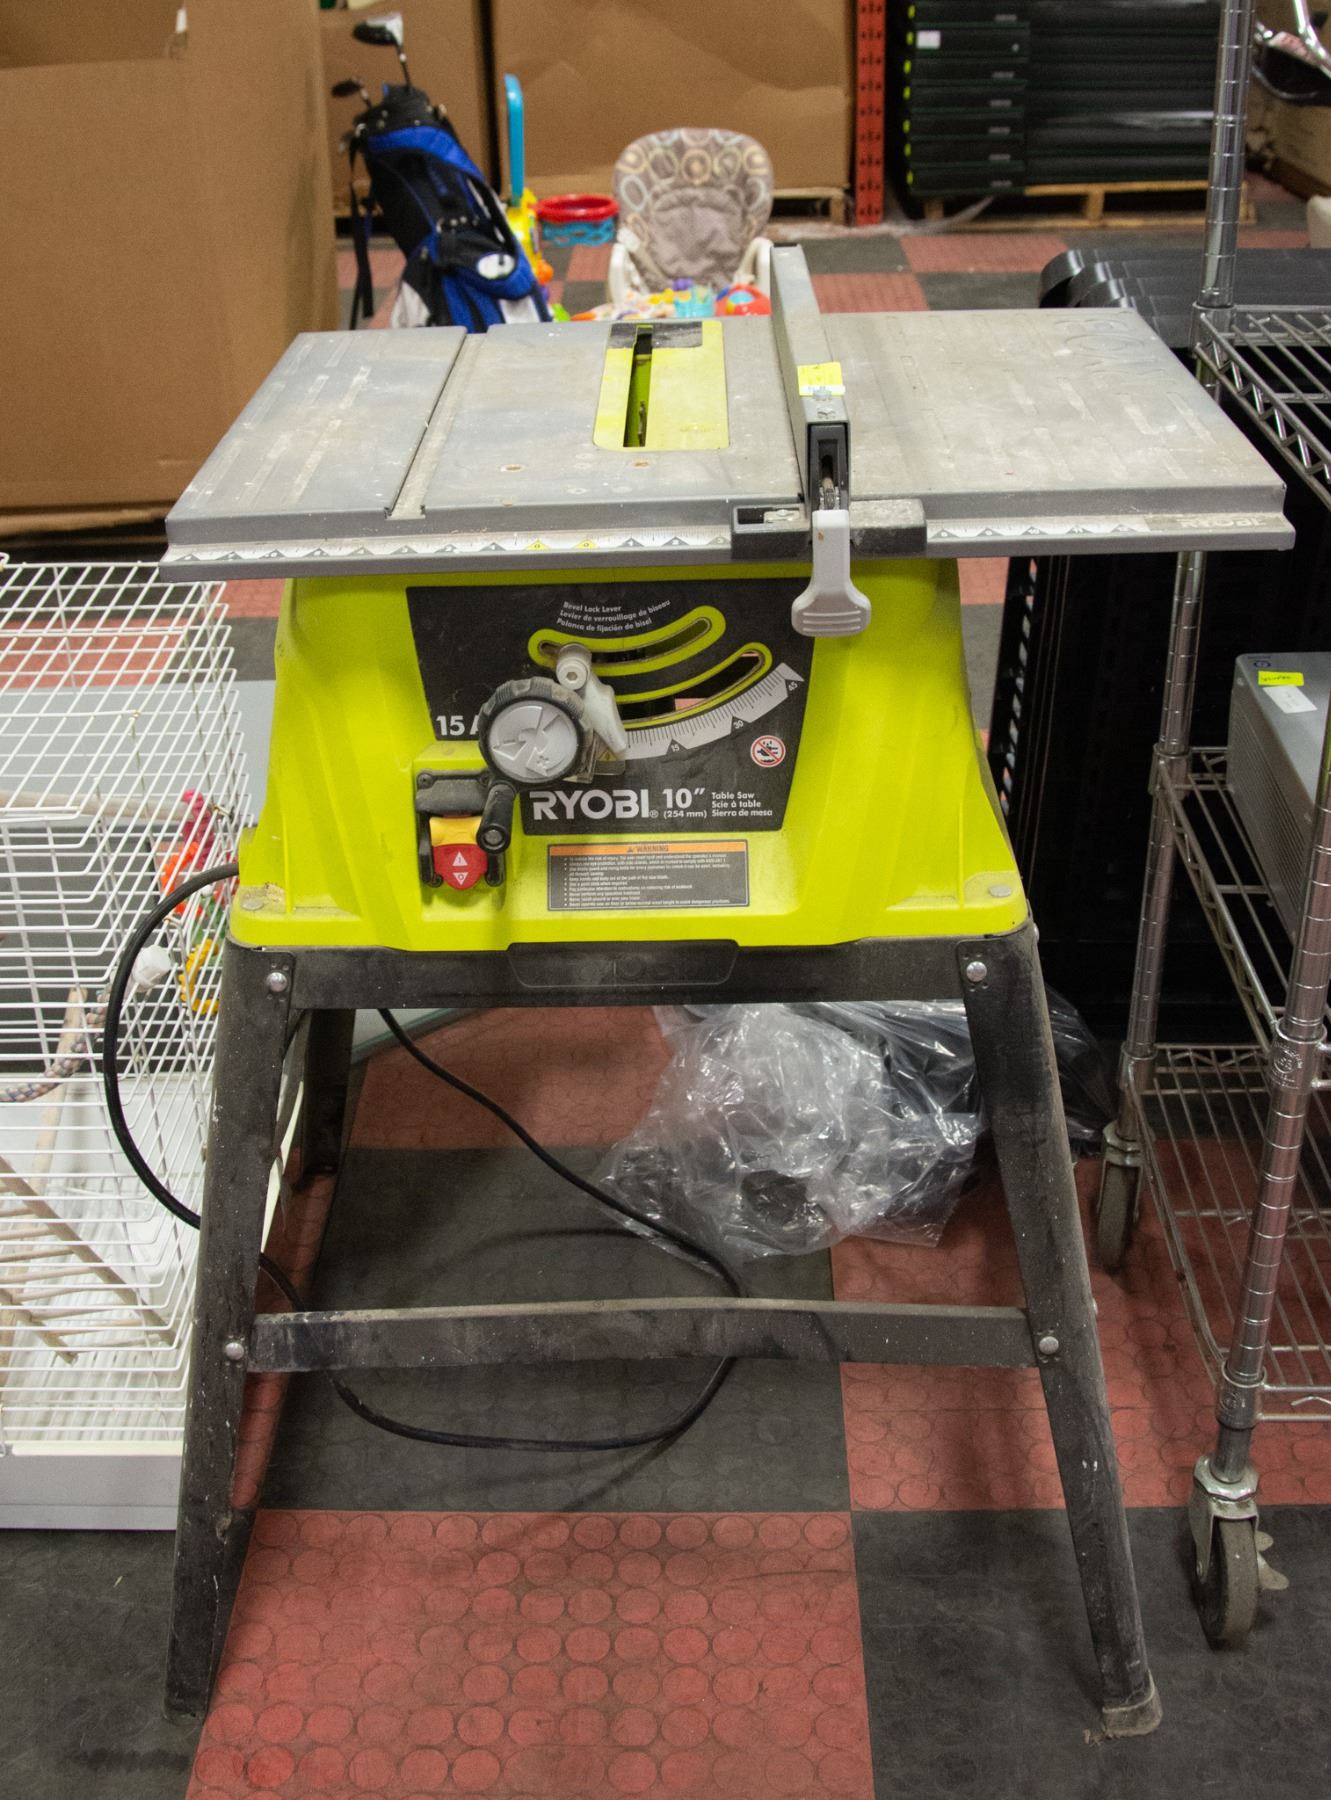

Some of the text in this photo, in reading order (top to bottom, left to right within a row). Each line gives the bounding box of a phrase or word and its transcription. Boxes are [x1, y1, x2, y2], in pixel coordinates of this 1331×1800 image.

[560, 610, 582, 621] Levier
[638, 609, 647, 617] de
[648, 600, 671, 614] biseau
[563, 602, 582, 611] Bevel
[584, 604, 600, 612] Lock
[556, 617, 584, 631] Palanca
[586, 623, 595, 631] de
[635, 618, 653, 629] bisel
[788, 682, 798, 692] 45
[436, 715, 465, 736] 15
[733, 720, 744, 730] 30
[671, 743, 680, 752] 15
[711, 791, 755, 800] Table Saw
[529, 789, 649, 821] RYOBI
[711, 800, 761, 809] Scie à table
[663, 809, 708, 819] (254 mm)
[711, 809, 737, 818] Sierra
[739, 809, 749, 817] de
[637, 845, 669, 853] WARNING
